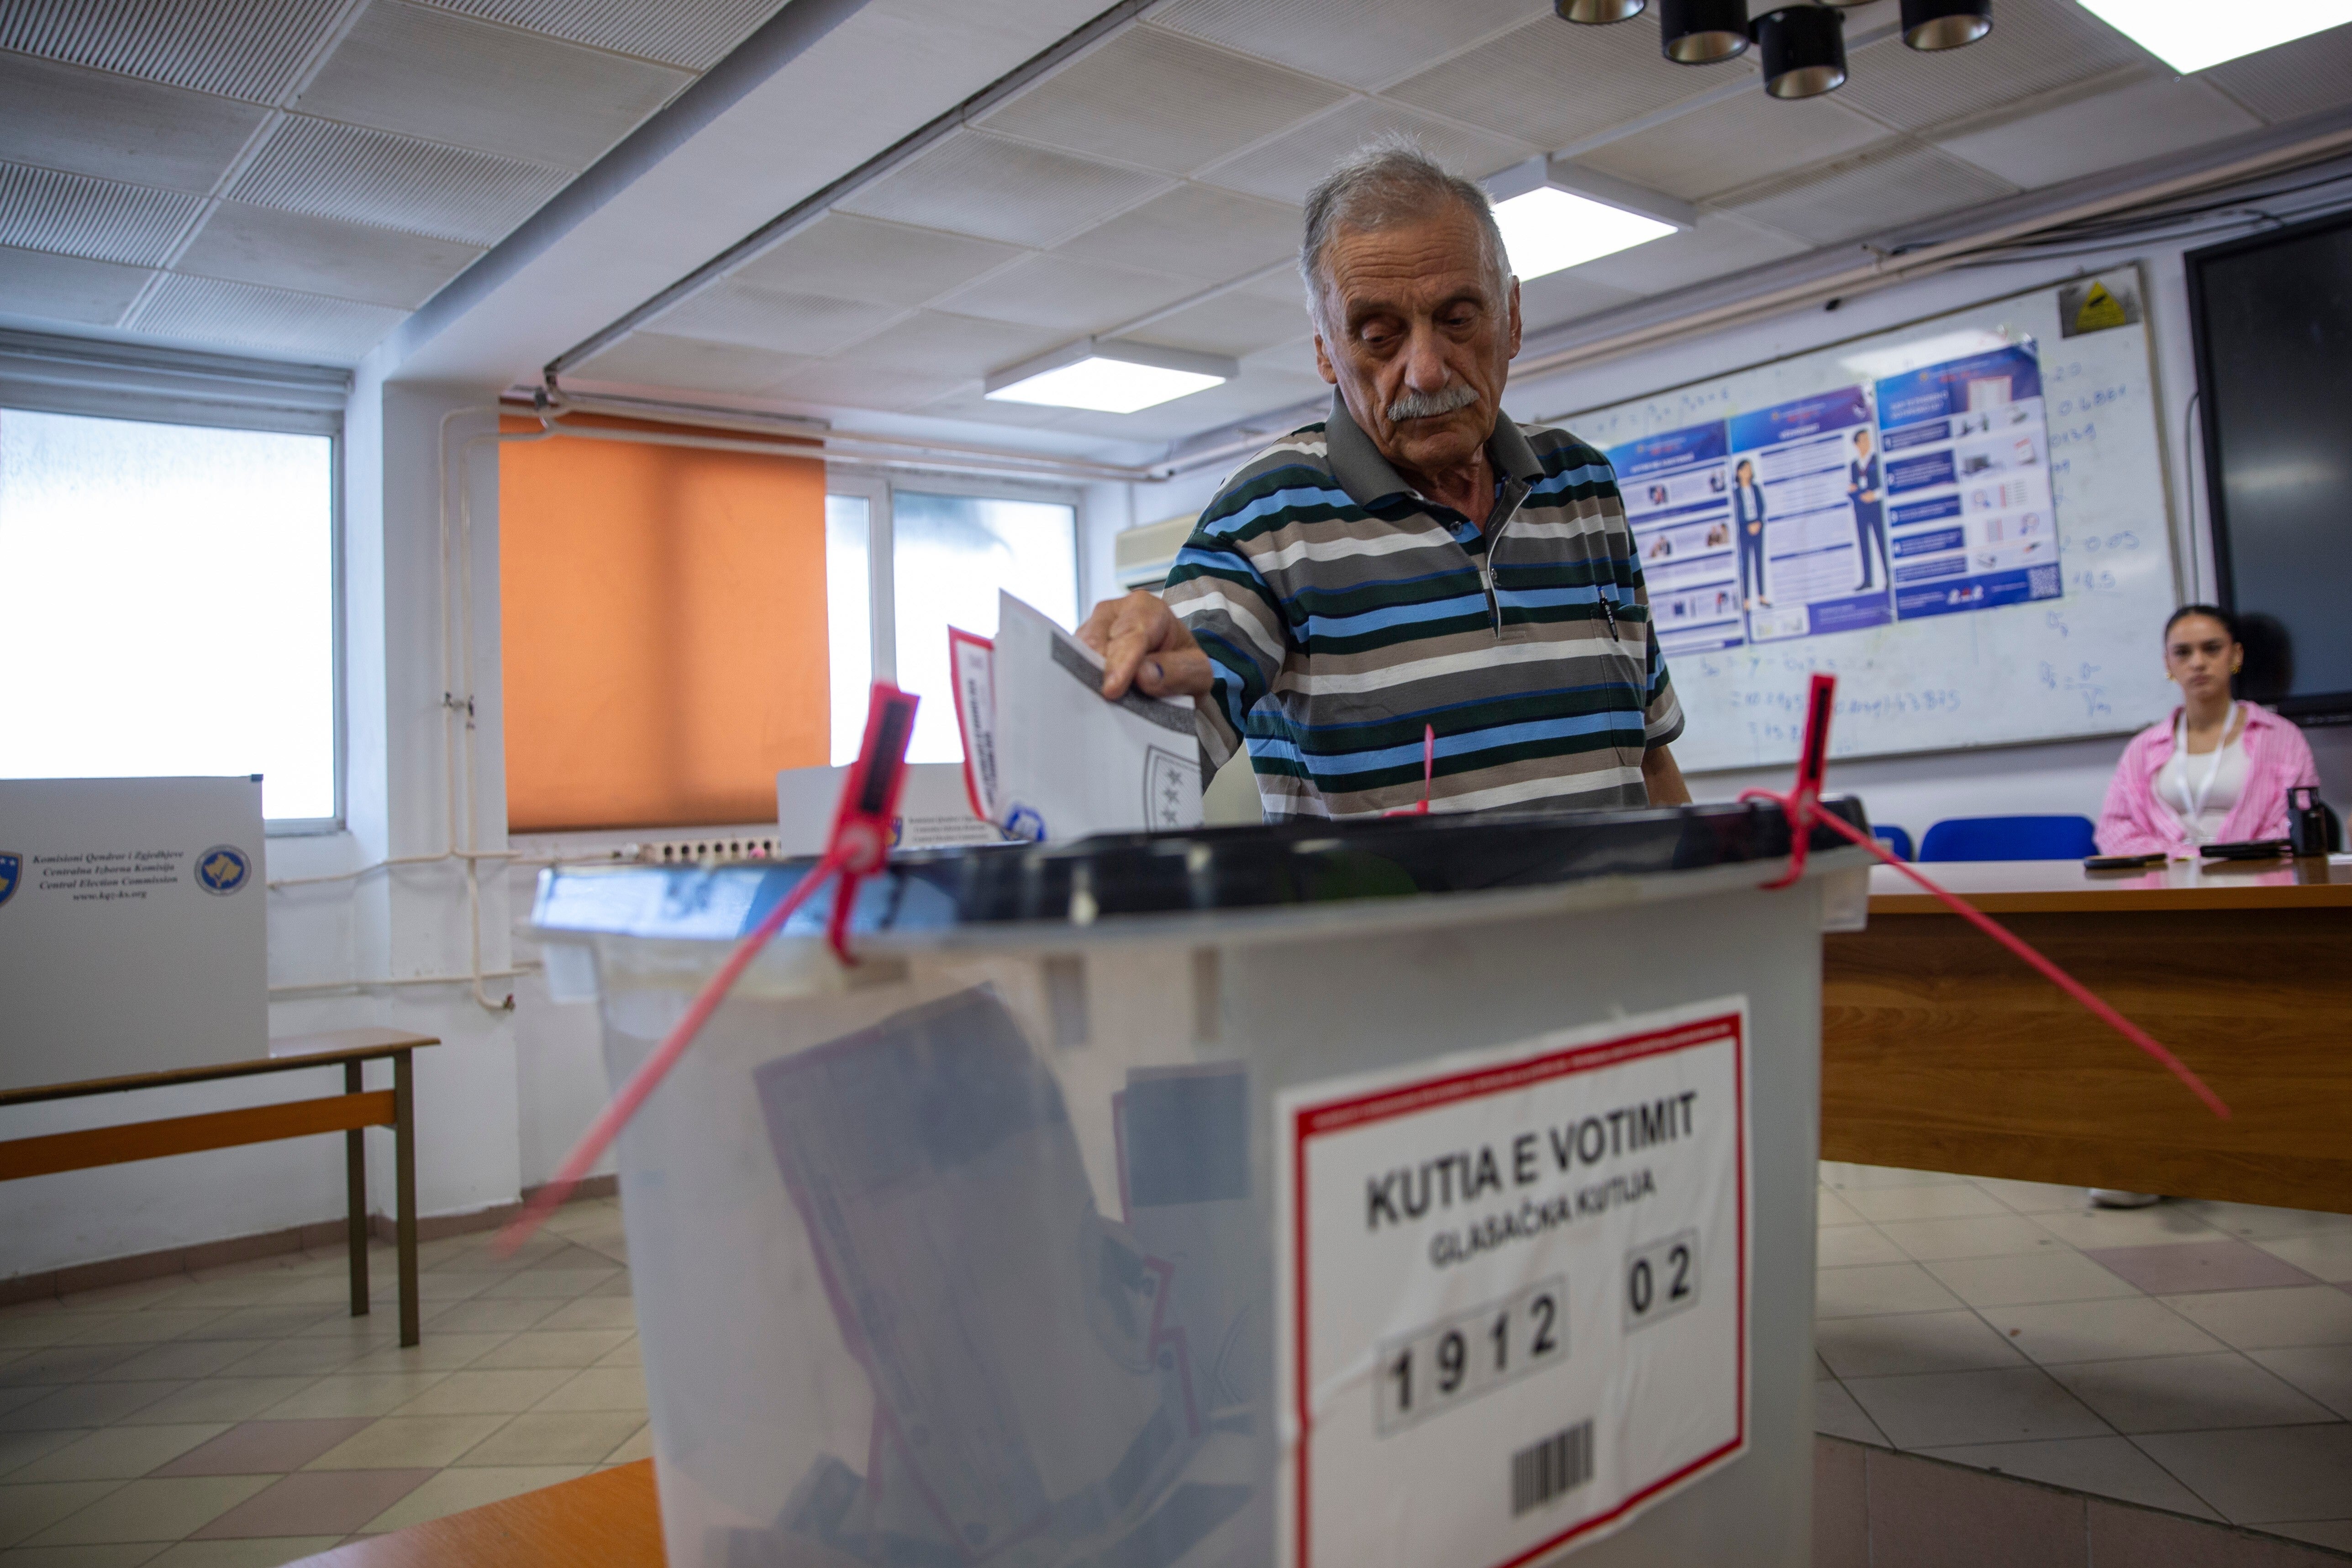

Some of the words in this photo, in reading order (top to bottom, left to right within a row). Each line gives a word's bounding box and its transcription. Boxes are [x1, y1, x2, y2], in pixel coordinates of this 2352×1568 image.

[33, 854, 83, 863] Komisioni
[85, 852, 125, 864] Qendror
[39, 879, 77, 889] Central
[79, 878, 118, 888] Election
[121, 876, 178, 887] Commission
[43, 867, 92, 876] Centralna
[134, 863, 174, 873] Komisija
[1365, 1143, 1503, 1232] KUTIA
[1514, 1133, 1539, 1188] E
[1548, 1090, 1698, 1172] VOTIMIT
[1430, 1195, 1573, 1269] GLASAČKA
[1575, 1169, 1657, 1218] KUTIJA
[1389, 1292, 1558, 1413] 1912
[1628, 1243, 1691, 1315] 02
